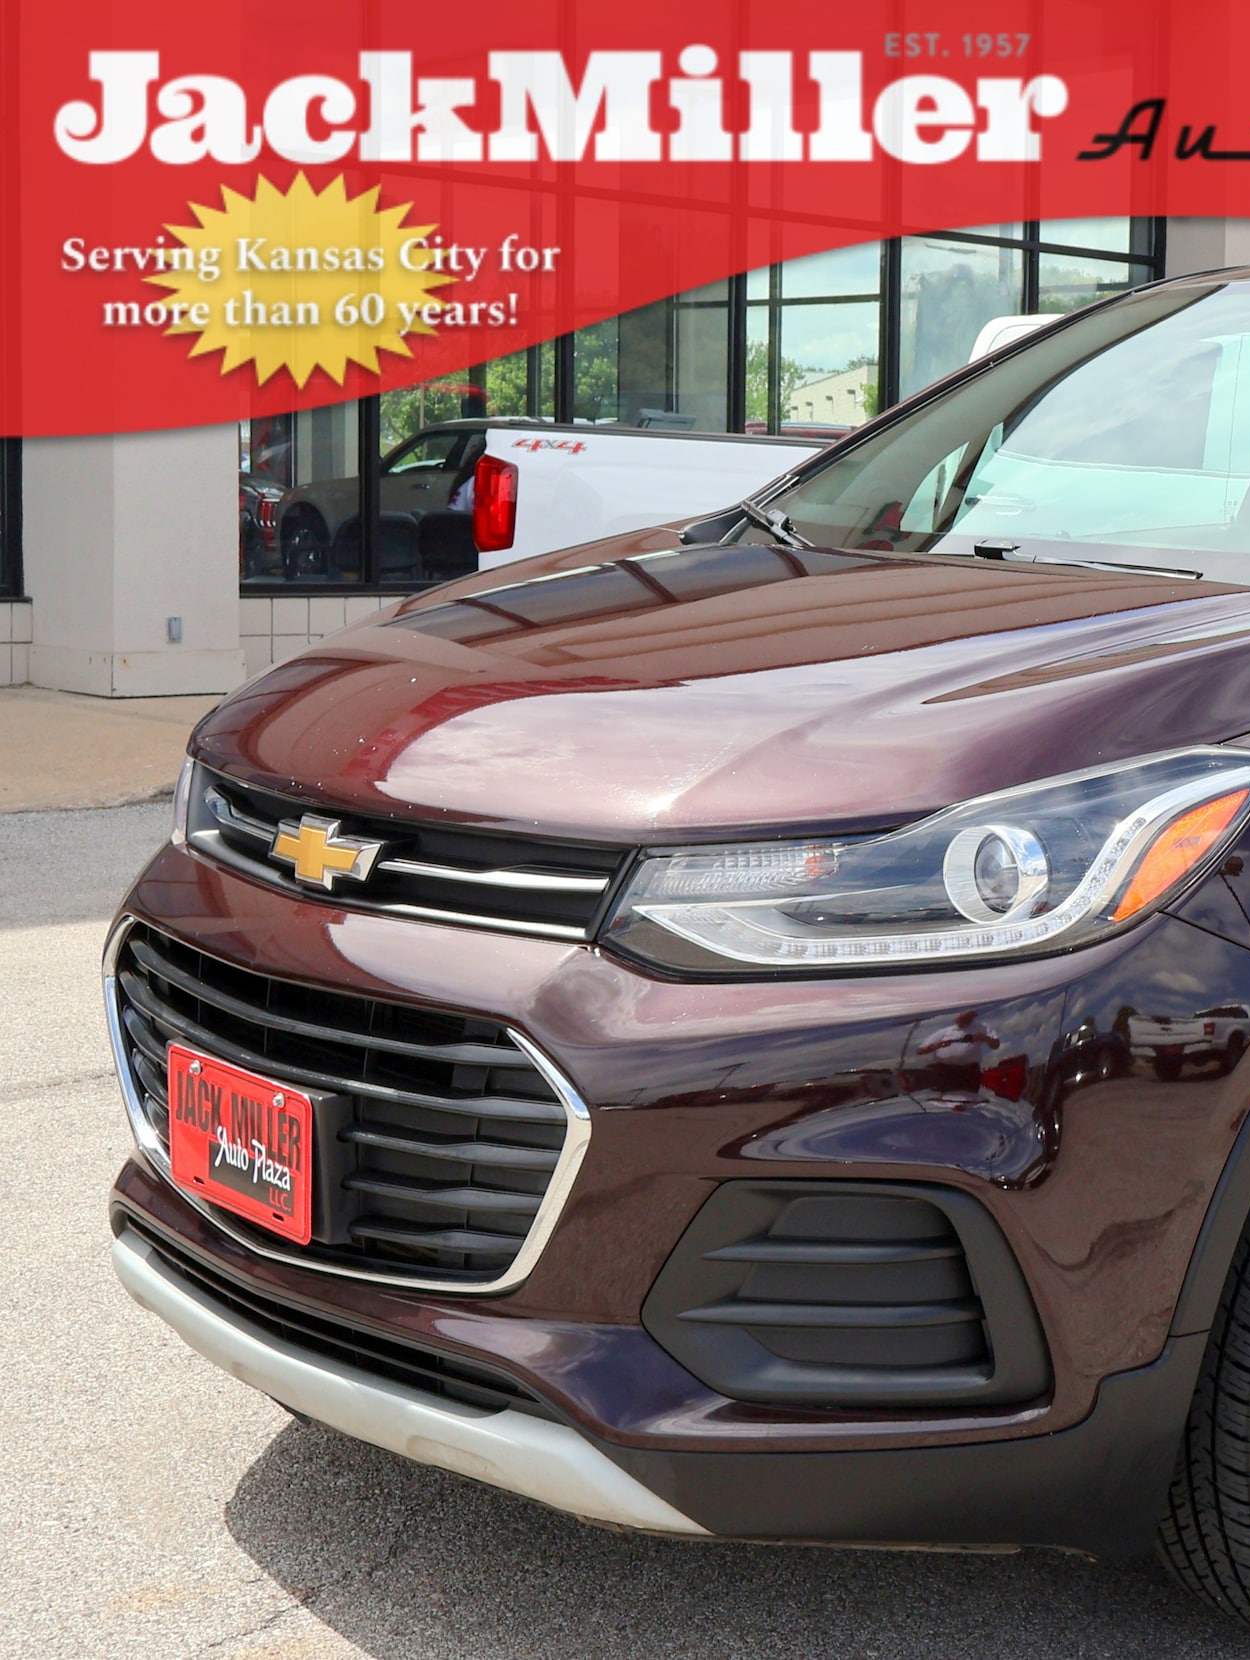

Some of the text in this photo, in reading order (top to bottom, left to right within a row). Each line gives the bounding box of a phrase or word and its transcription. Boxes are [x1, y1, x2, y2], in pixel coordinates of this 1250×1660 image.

[175, 1070, 301, 1172] JACK MILLER
[214, 1125, 291, 1191] Auto Plaza
